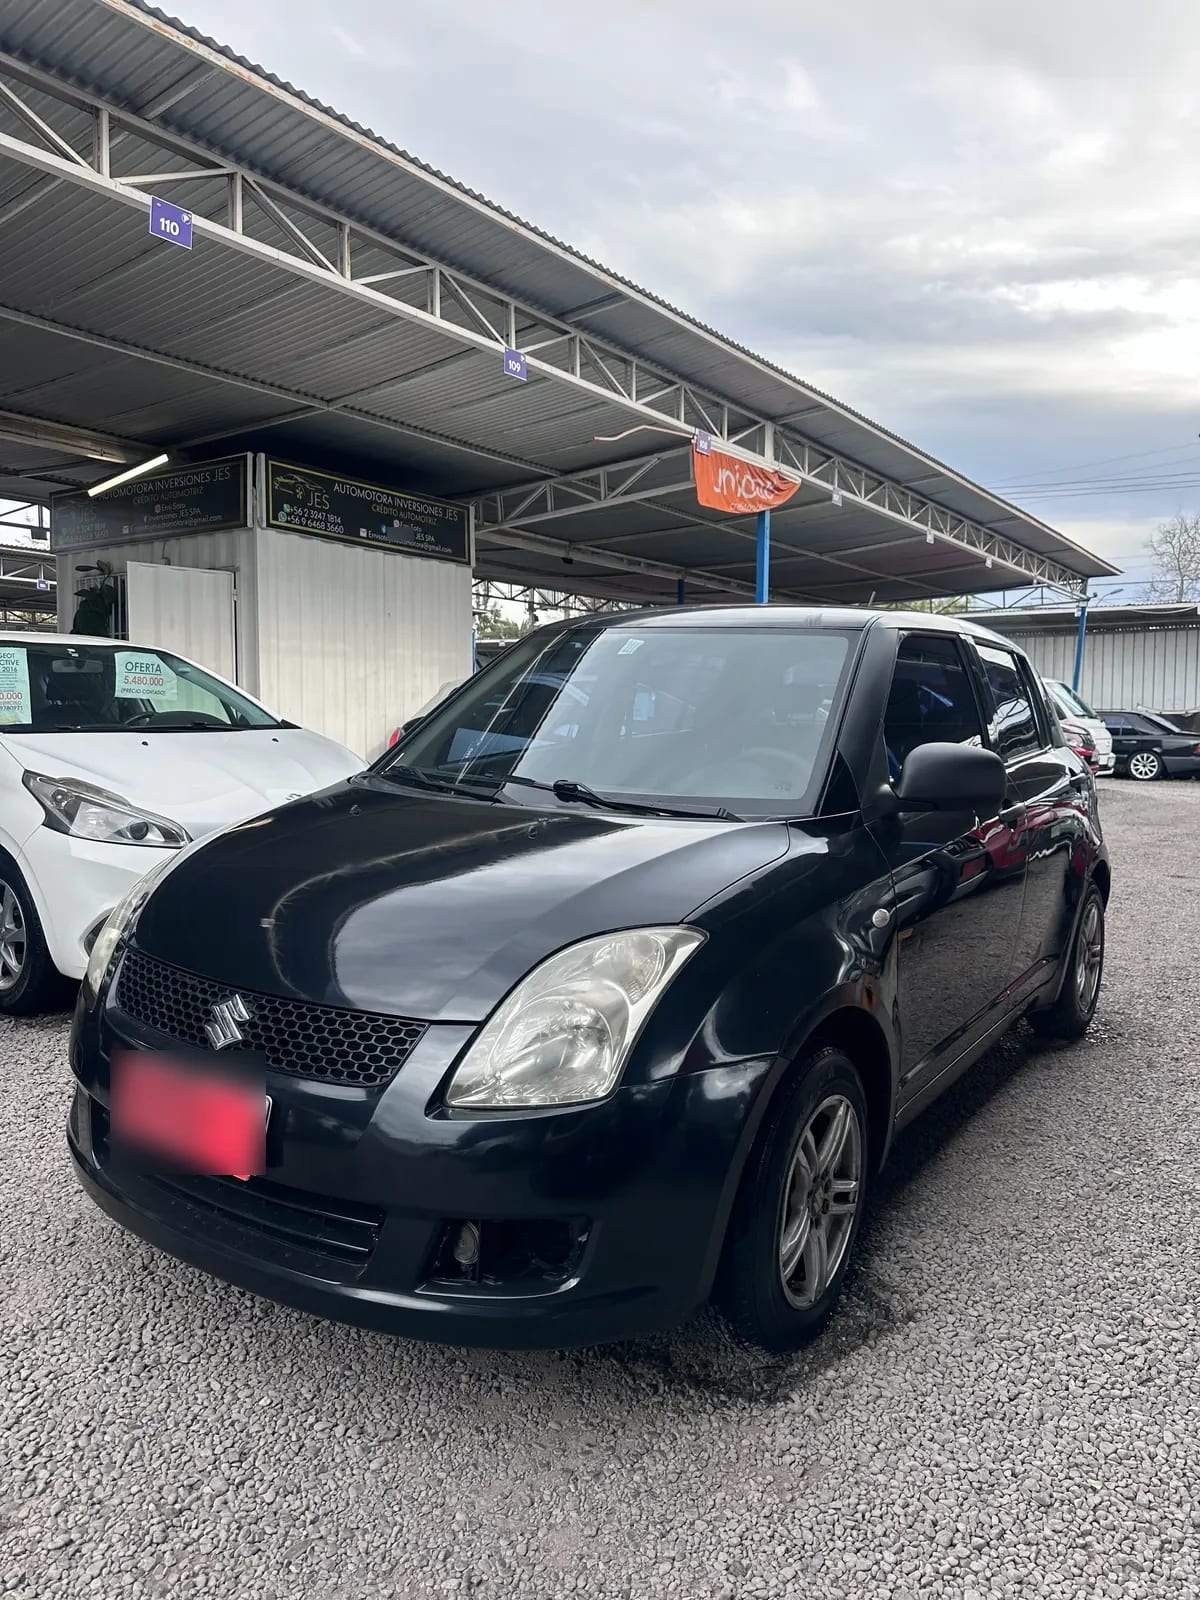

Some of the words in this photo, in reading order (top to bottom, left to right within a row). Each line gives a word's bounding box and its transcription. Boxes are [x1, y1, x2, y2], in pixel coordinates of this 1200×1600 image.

[160, 217, 179, 236] 110
[508, 359, 521, 373] 109
[155, 472, 211, 491] INVERSIONES
[213, 466, 231, 482] JES
[307, 491, 330, 510] JES
[333, 482, 394, 505] AUTOMOTORA
[394, 497, 443, 517] INVERSIONES
[443, 505, 458, 521] JES
[303, 508, 309, 518] 2
[309, 509, 326, 521] 3247
[327, 513, 341, 524] 1814
[371, 503, 399, 517] CRÉDITO
[399, 511, 438, 526] AUTOMOTRIZ
[301, 517, 307, 526] 9
[307, 518, 326, 530] 6468
[326, 522, 345, 534] 3660
[125, 661, 162, 673] OFERTA
[123, 675, 164, 687] 5.480.000
